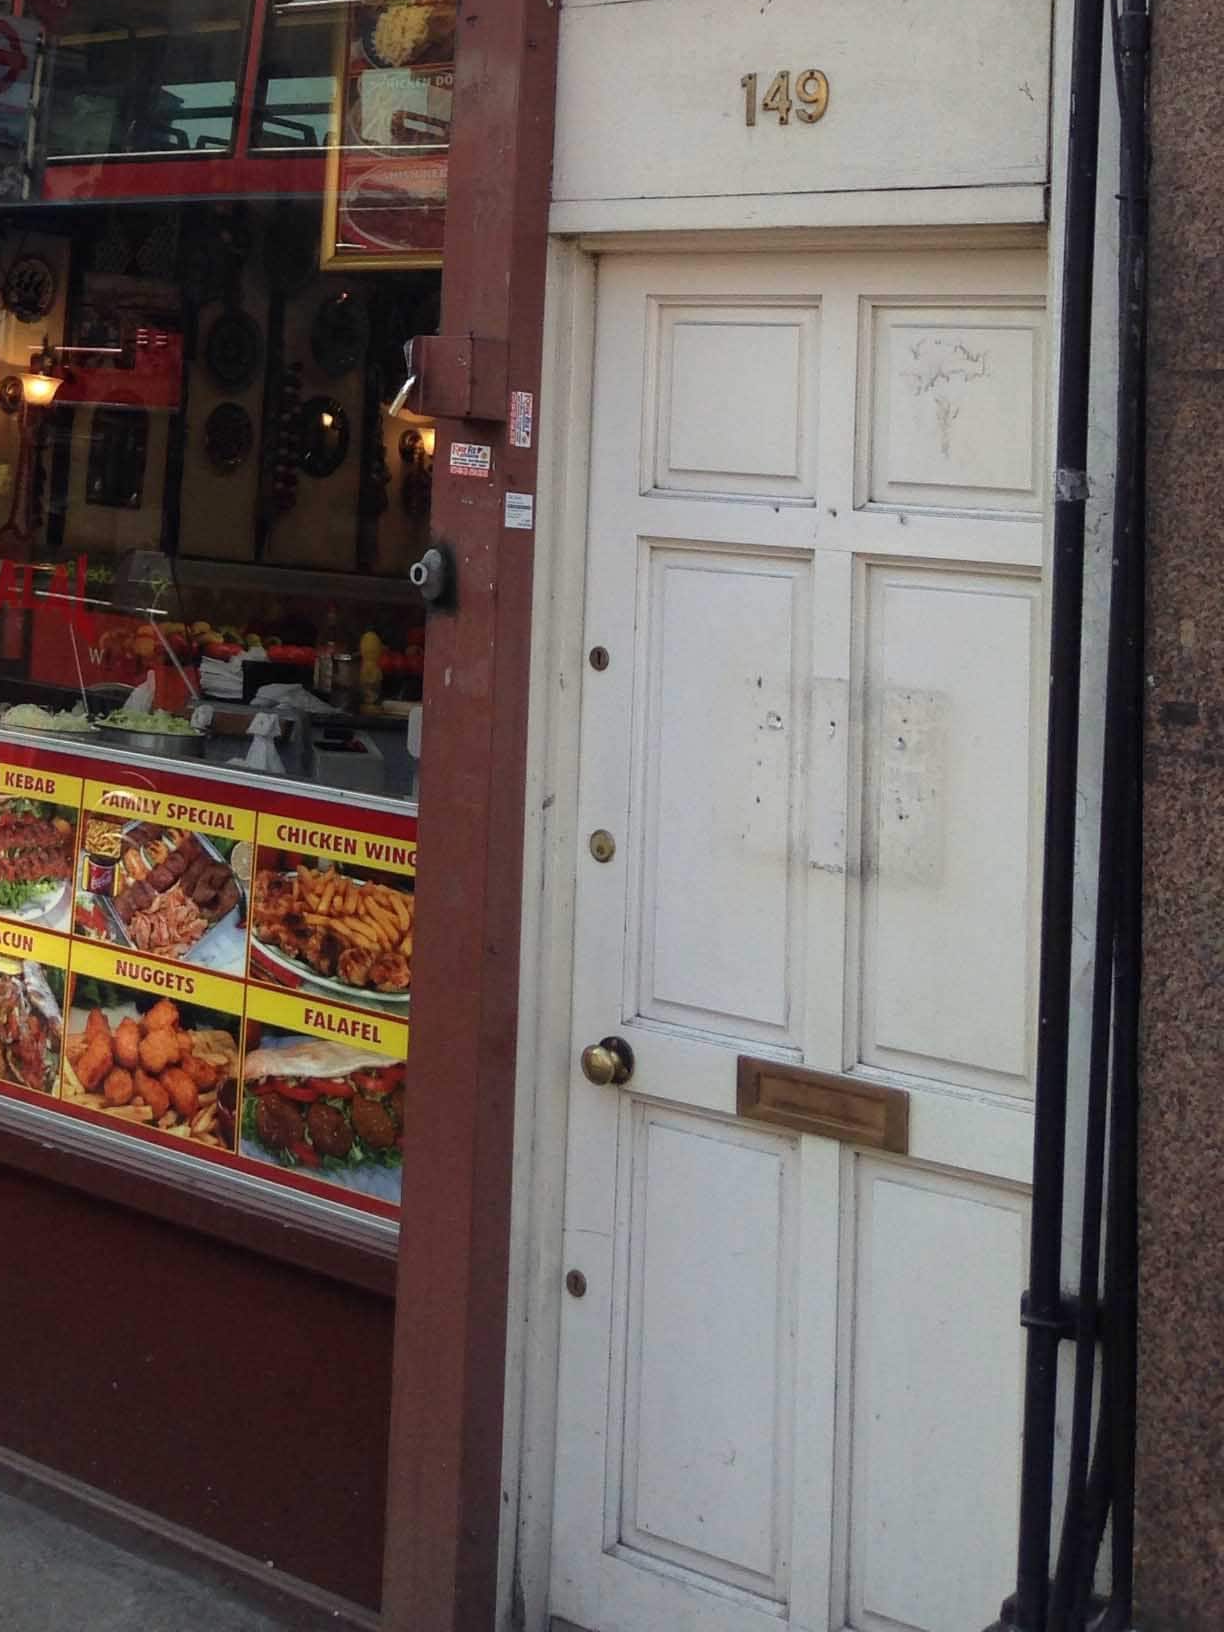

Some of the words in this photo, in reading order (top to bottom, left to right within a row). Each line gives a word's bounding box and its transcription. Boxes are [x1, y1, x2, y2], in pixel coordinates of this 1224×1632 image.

[741, 69, 829, 128] 149
[5, 772, 56, 795] KEBAB
[101, 790, 161, 816] FAMILY
[166, 802, 235, 831] SPECIAL
[276, 824, 358, 855] CHICKEN
[116, 959, 195, 995] NUGGETS
[303, 1007, 382, 1044] FALAFEL
